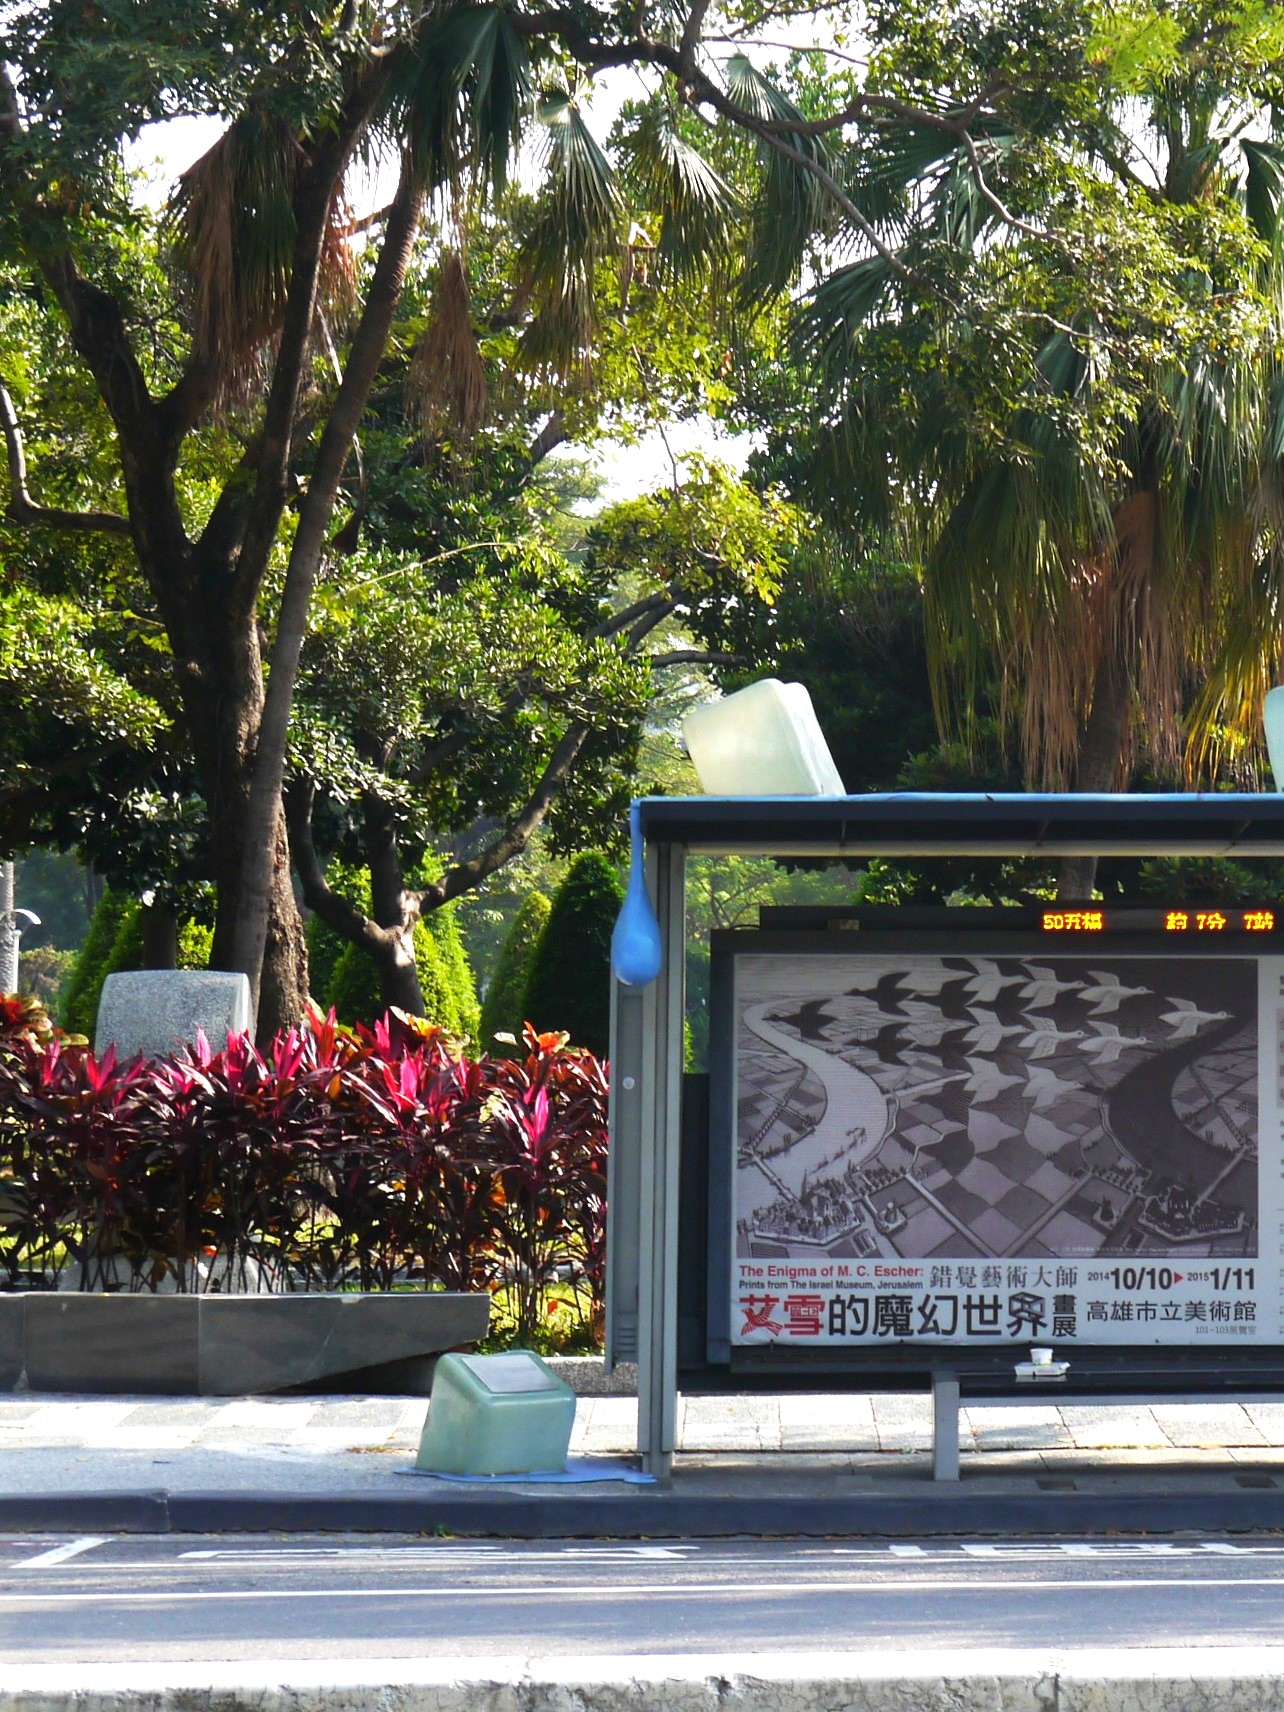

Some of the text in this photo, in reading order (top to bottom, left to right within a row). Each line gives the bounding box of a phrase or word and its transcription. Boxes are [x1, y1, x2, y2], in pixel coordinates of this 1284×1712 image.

[739, 1265, 925, 1280] The Enigma of M. C. Escher:
[929, 1265, 1078, 1289] 錯覺藝術大師
[1087, 1266, 1255, 1291] 2014 10/10 2015 1/11
[739, 1280, 923, 1292] Prints from The Israel Museum, Jerusalem
[1086, 1300, 1257, 1322] 高雄市立美術館
